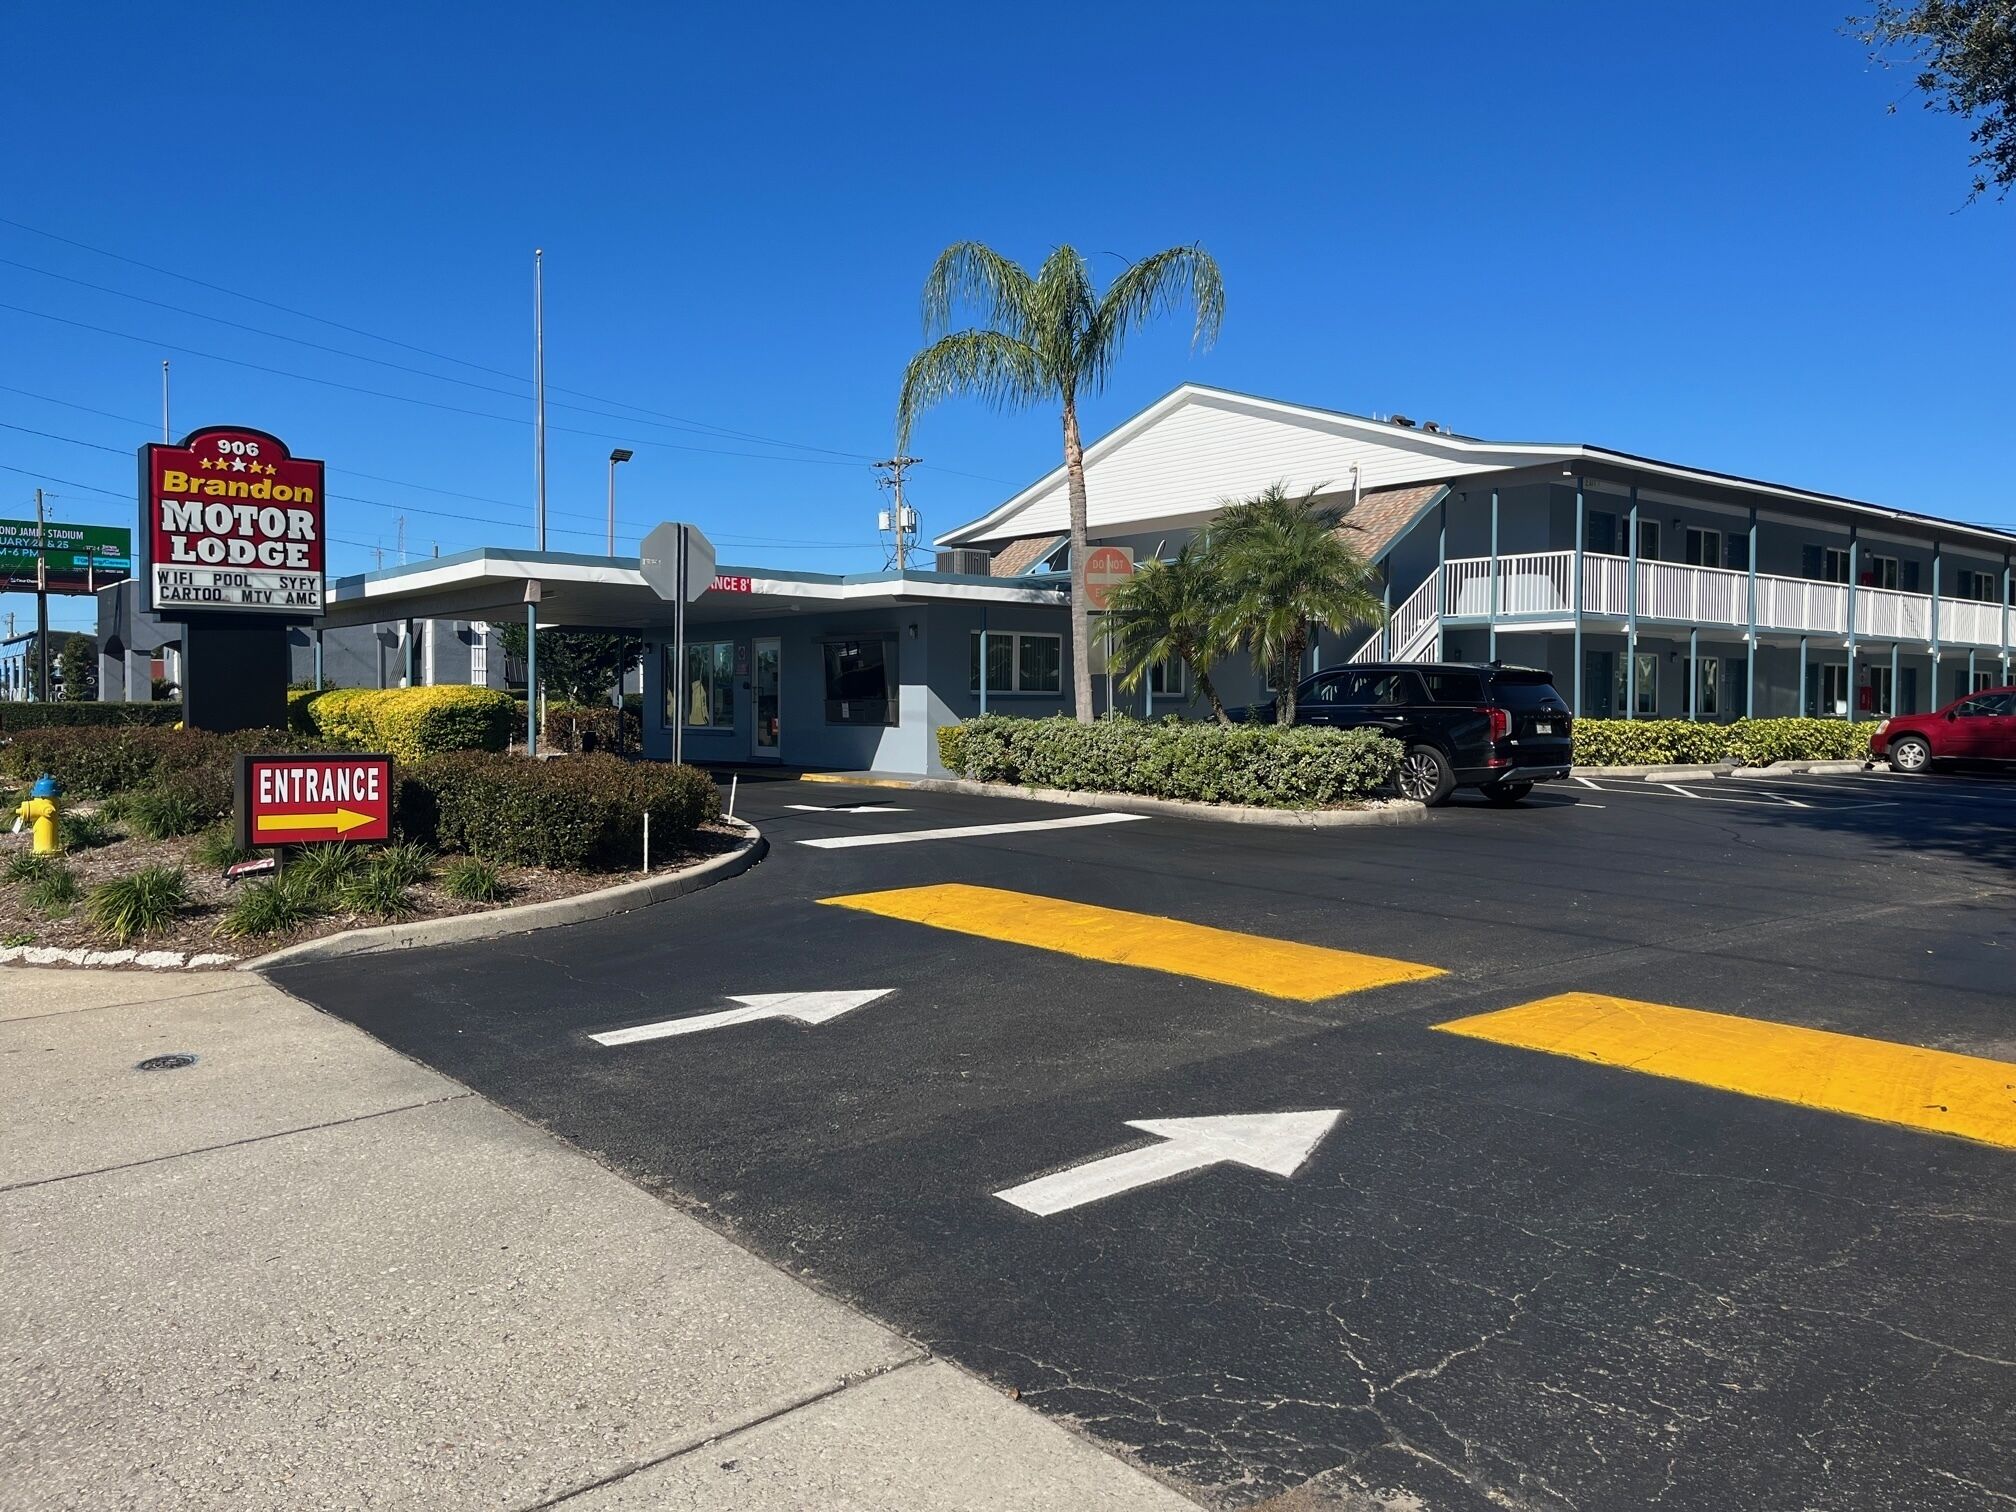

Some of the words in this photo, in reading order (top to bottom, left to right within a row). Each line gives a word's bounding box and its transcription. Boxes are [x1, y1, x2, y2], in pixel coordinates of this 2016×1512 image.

[217, 439, 260, 457] 906
[164, 470, 314, 503] Brandon
[161, 499, 316, 541] MOTOR
[47, 529, 84, 540] STADIUM
[47, 540, 55, 548] &
[57, 540, 69, 549] 25
[170, 535, 310, 568] LODGE
[1092, 559, 1104, 569] DO
[1108, 559, 1124, 570] NOT
[158, 571, 193, 585] WIFI
[213, 573, 252, 587] POOL
[279, 576, 316, 590] SYFY
[161, 586, 222, 601] CARTOO
[241, 590, 273, 604] MTV
[285, 591, 317, 605] AMC
[259, 767, 380, 804] ENTRANCE
